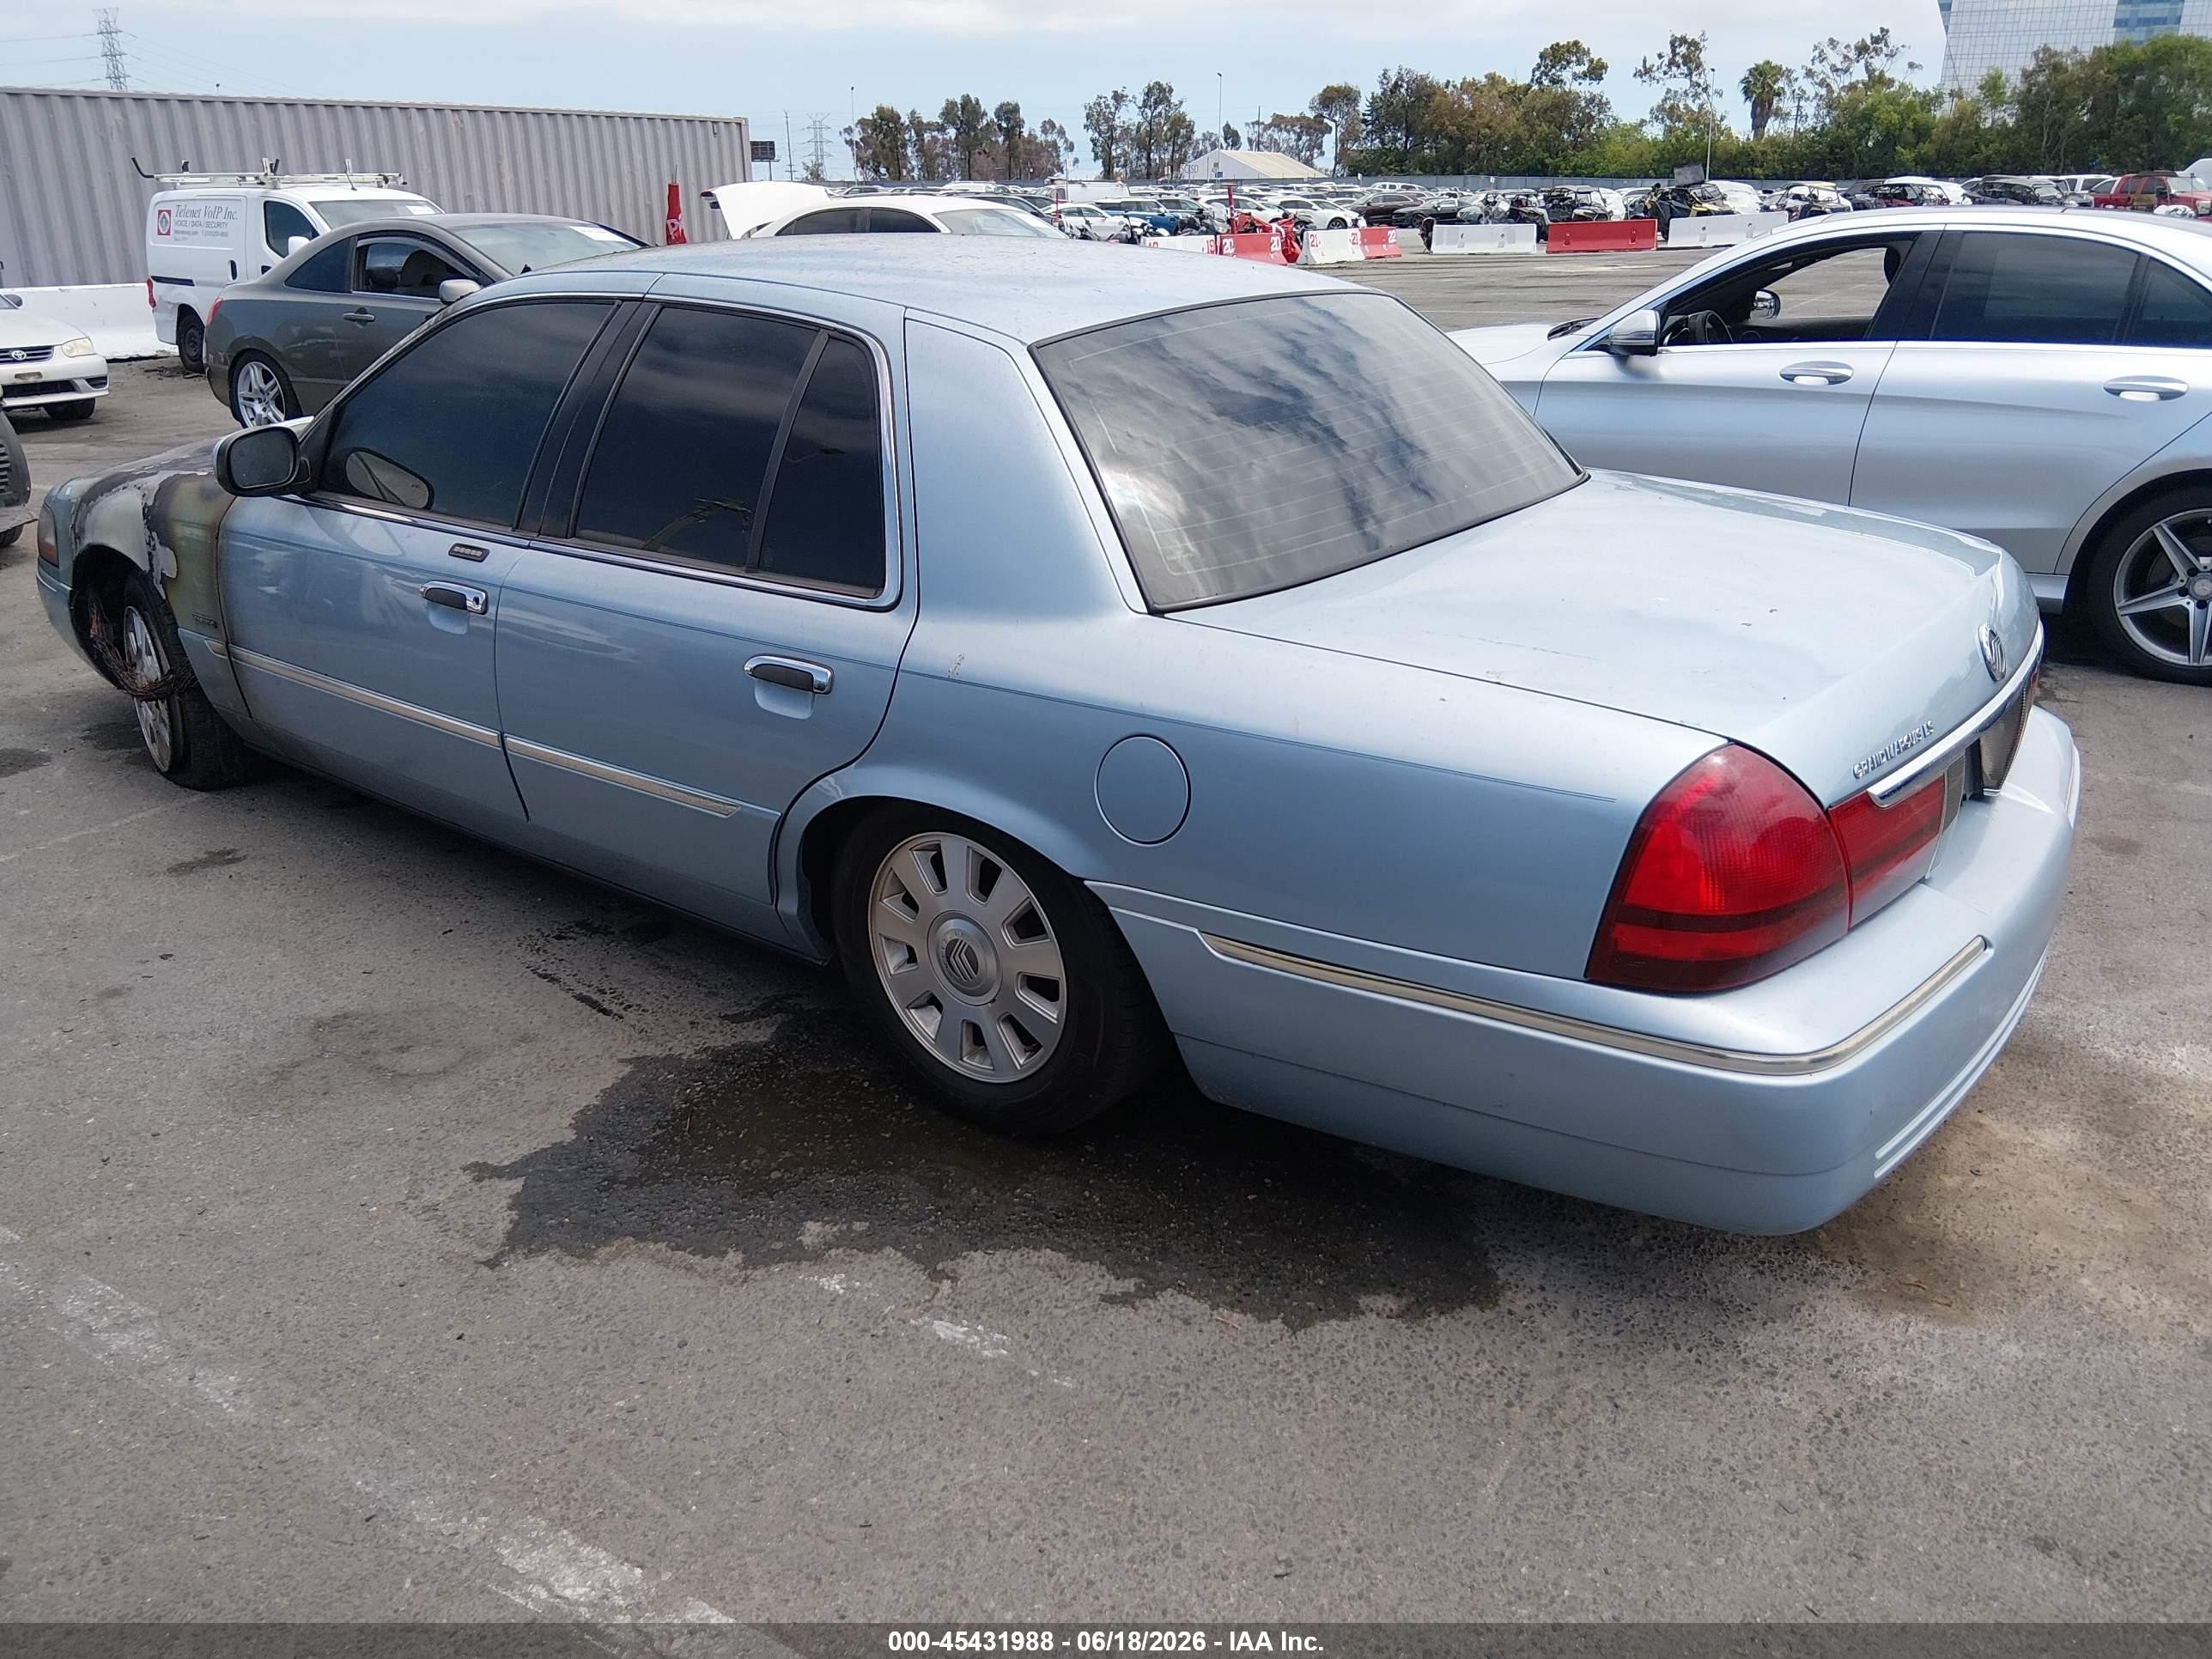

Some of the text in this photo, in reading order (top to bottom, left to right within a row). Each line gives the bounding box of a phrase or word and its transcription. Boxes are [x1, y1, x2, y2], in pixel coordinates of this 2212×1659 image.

[175, 204, 238, 221] Telenet VoIP Inc.
[174, 219, 189, 228] VOICE
[1270, 236, 1281, 252] 20
[1310, 234, 1319, 247] 21
[1351, 232, 1359, 246] 21
[1387, 229, 1397, 244] 22
[1223, 238, 1235, 254] 20
